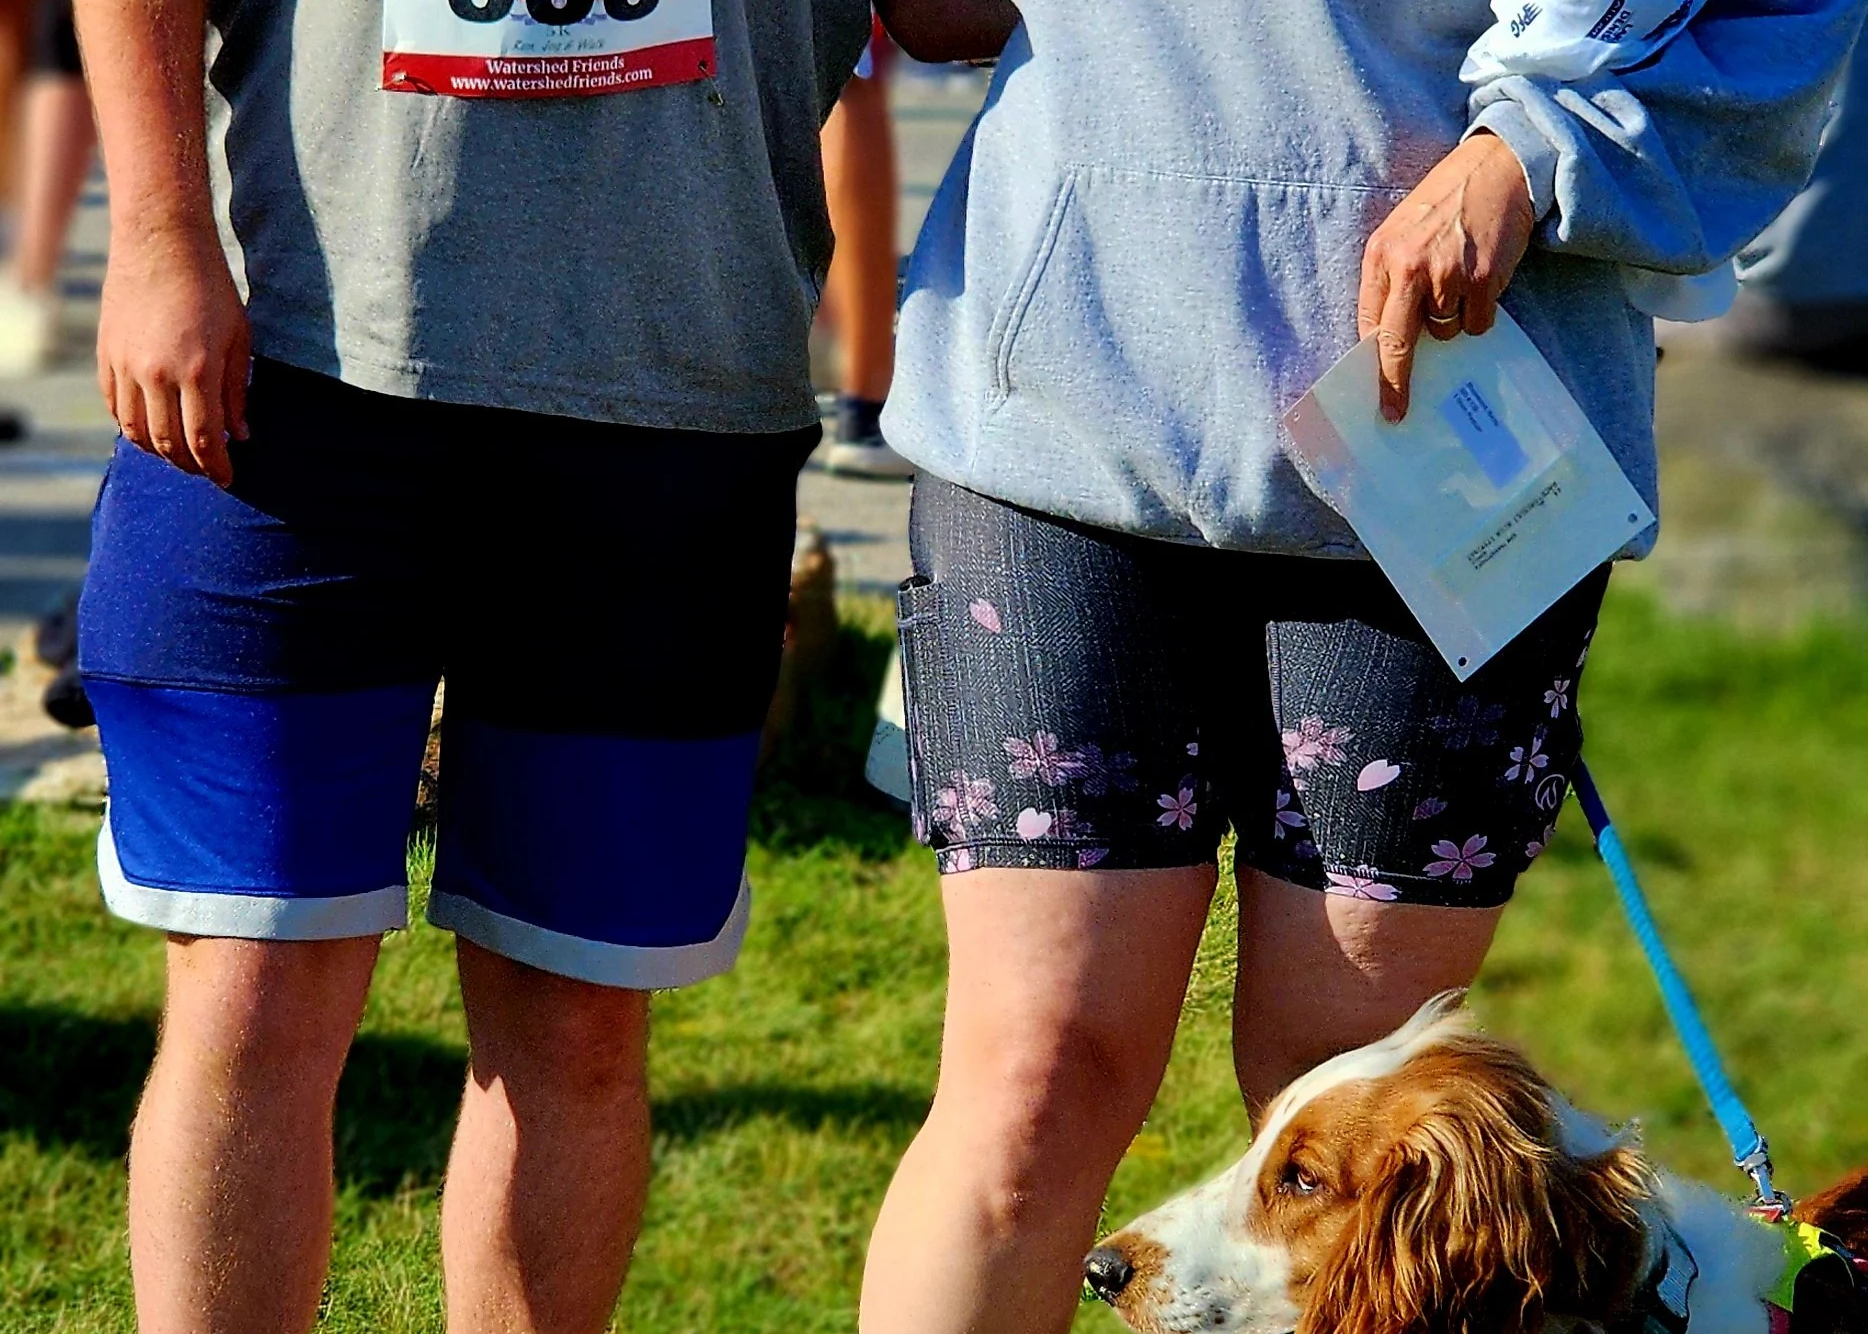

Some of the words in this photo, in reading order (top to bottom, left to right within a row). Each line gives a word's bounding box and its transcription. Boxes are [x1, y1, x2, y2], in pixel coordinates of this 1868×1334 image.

[486, 60, 568, 74] Watershed
[571, 56, 625, 73] Friends
[450, 67, 653, 91] www.watershedfriends.com
